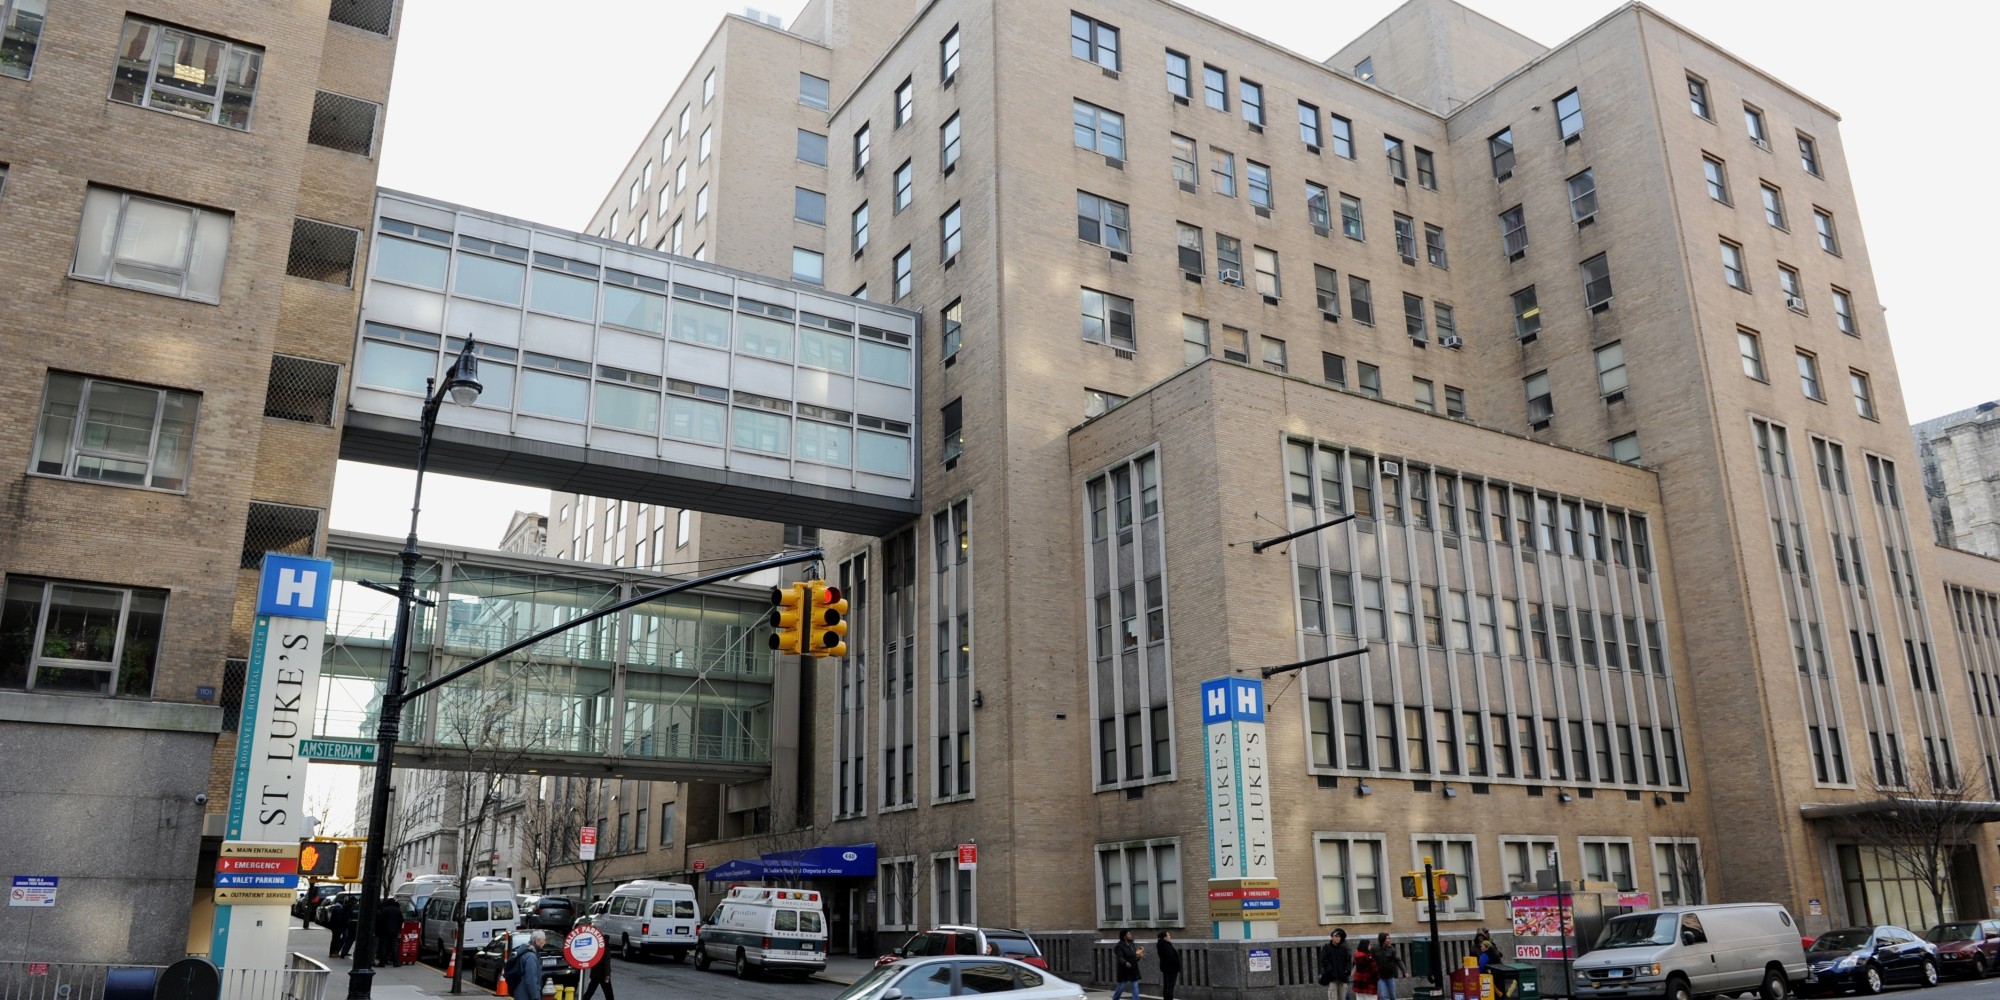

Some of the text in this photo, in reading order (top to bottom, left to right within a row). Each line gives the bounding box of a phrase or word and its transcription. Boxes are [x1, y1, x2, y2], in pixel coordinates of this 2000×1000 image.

[276, 568, 318, 608] H
[240, 715, 253, 768] ROOSEVELT
[247, 670, 259, 710] HOSPITAL
[253, 631, 265, 665] CENTER
[1208, 687, 1226, 717] H
[1237, 686, 1257, 714] H
[259, 634, 309, 826] ST. LUKE'S
[301, 742, 373, 759] AMSTERDAM AV
[1214, 733, 1234, 867] ST. LUKE'S
[1246, 733, 1267, 866] ST. LUKE'S
[234, 861, 281, 869] EMERGENCY
[232, 876, 285, 884] VALET PARKING
[564, 926, 605, 949] VALET PARKING
[1517, 946, 1540, 957] GYRO
